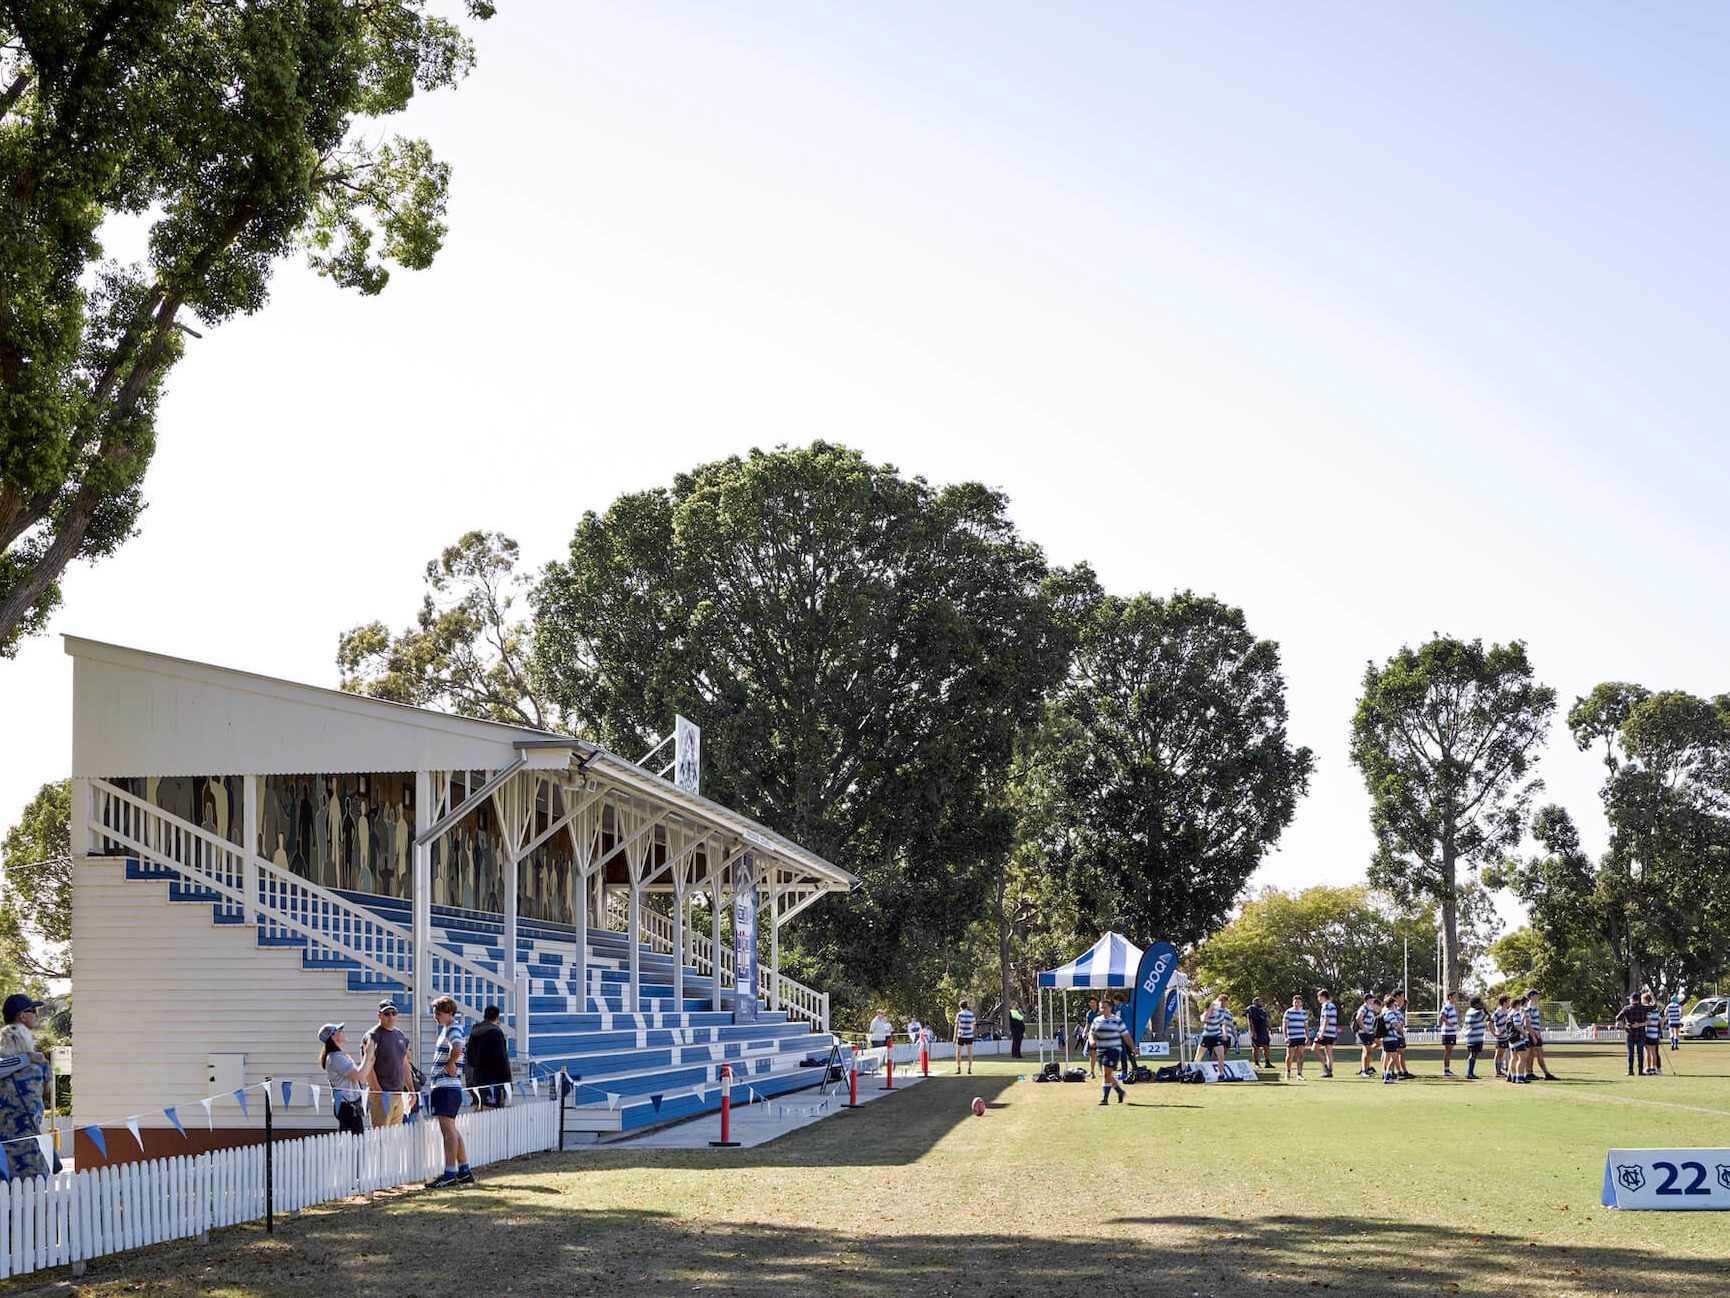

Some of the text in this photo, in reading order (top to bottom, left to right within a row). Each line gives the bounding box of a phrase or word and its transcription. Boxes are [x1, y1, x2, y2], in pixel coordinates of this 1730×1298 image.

[1143, 961, 1167, 994] BOQ
[1148, 1044, 1161, 1053] 22
[1652, 1161, 1712, 1195] 22
